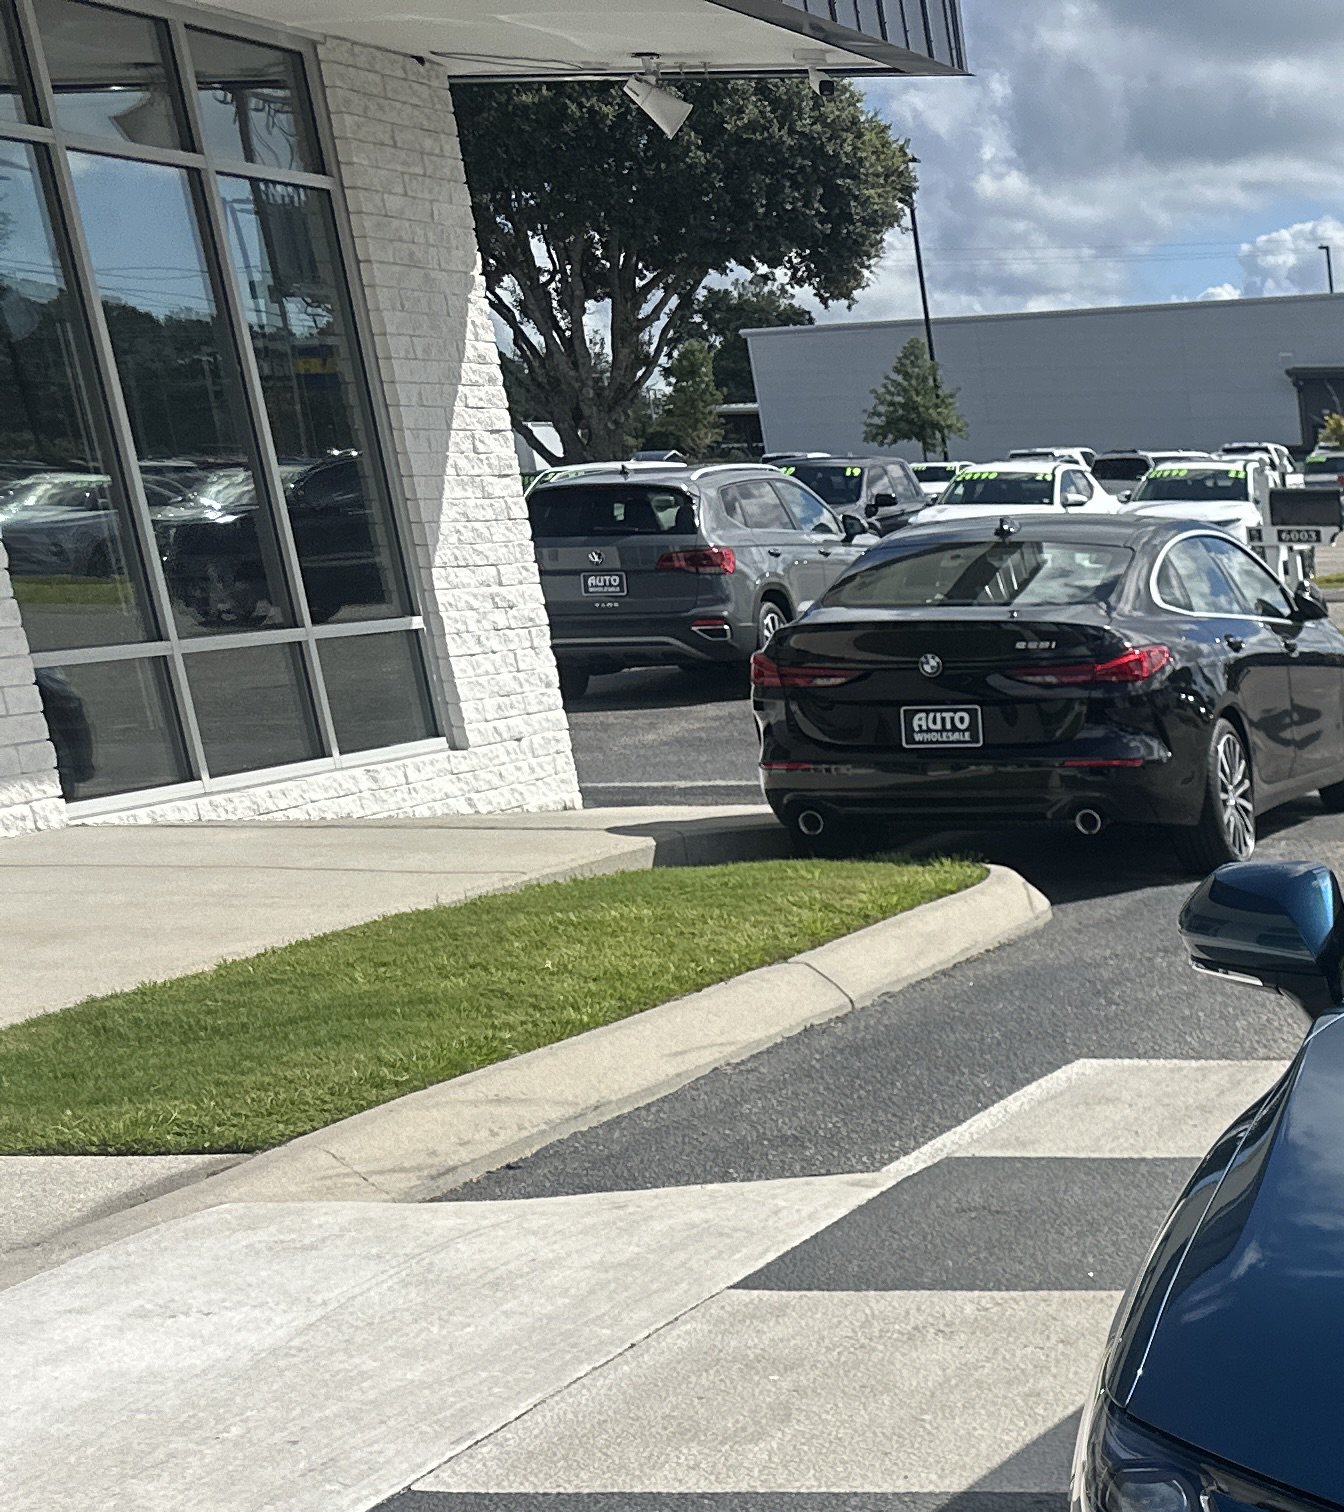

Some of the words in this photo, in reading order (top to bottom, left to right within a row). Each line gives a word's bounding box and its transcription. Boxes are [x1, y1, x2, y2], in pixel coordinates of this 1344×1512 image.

[1281, 531, 1317, 541] 6003
[587, 575, 620, 587] AUTO
[912, 711, 970, 732] AUTO
[913, 731, 971, 742] WHOLESALE
